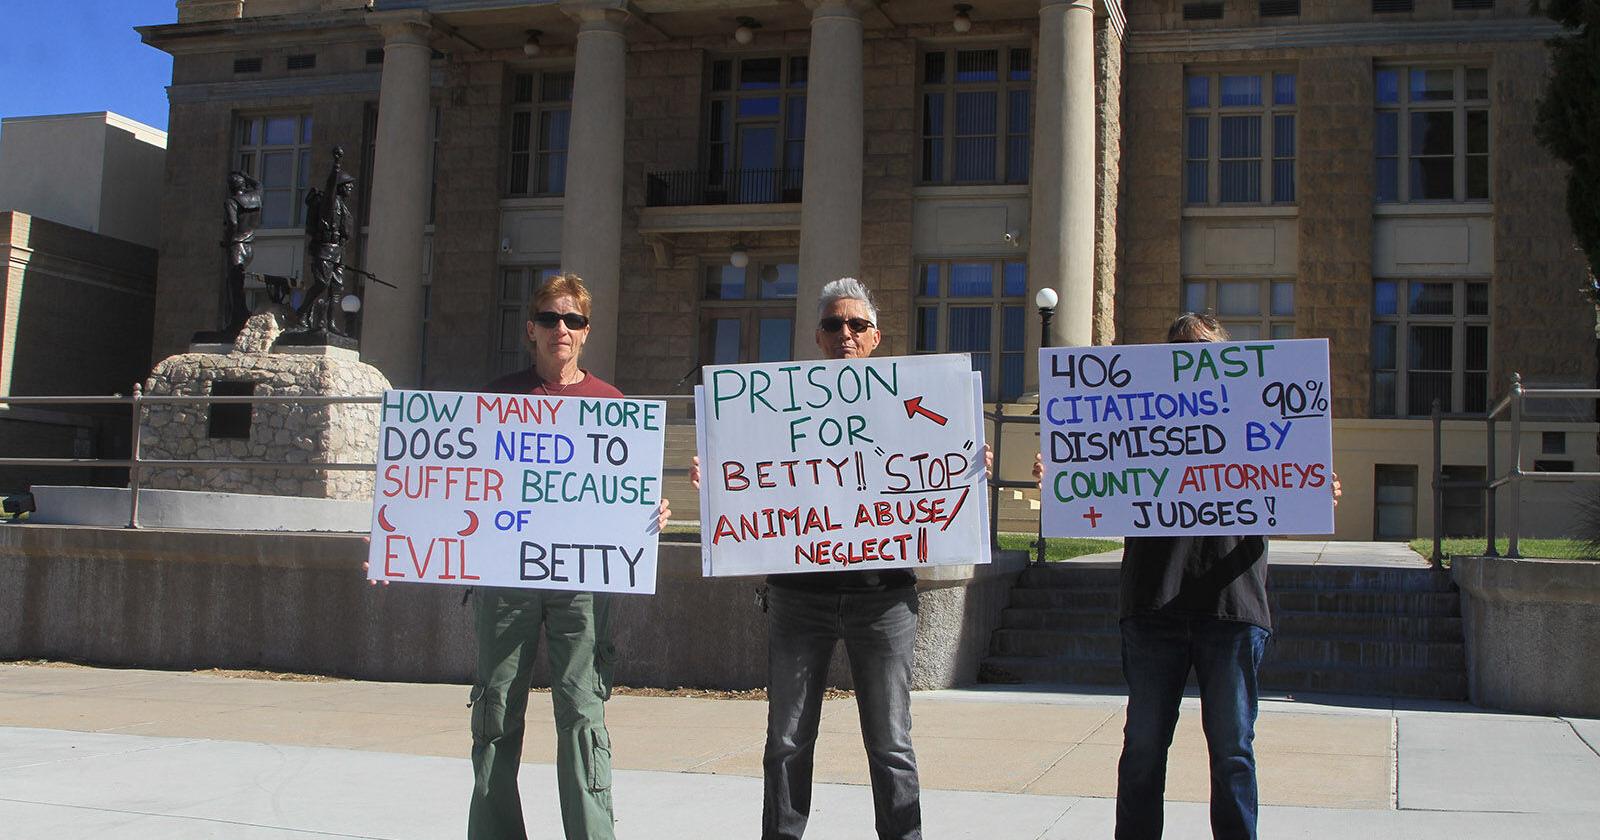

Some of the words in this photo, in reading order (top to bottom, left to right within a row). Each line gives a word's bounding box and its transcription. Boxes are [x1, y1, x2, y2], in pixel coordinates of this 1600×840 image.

[1051, 354, 1131, 388] 406
[1172, 345, 1275, 382] PAST
[383, 392, 463, 423] HOW
[477, 395, 564, 425] MANY
[579, 400, 660, 431] MORE
[713, 363, 898, 420] PRISON
[1046, 384, 1230, 426] CITATIONS!
[1262, 380, 1328, 416] 90%
[384, 427, 477, 461] DOGS
[495, 431, 574, 464] NEED
[587, 434, 628, 466] TO
[790, 415, 873, 452] FOR
[1050, 424, 1226, 463] DISMISSED
[1246, 421, 1292, 451] BY
[383, 464, 504, 501] SUFFER
[522, 470, 656, 505] BECAUSE
[722, 451, 867, 492] BETTY!!
[1054, 467, 1170, 503] COUNTY
[1178, 463, 1326, 494] ATTORNEYS
[495, 511, 531, 532] OF
[712, 506, 842, 545] ANIMAL
[384, 535, 480, 580] EVIL
[520, 541, 644, 587] BETTY
[795, 527, 928, 567] NEGLECT!!
